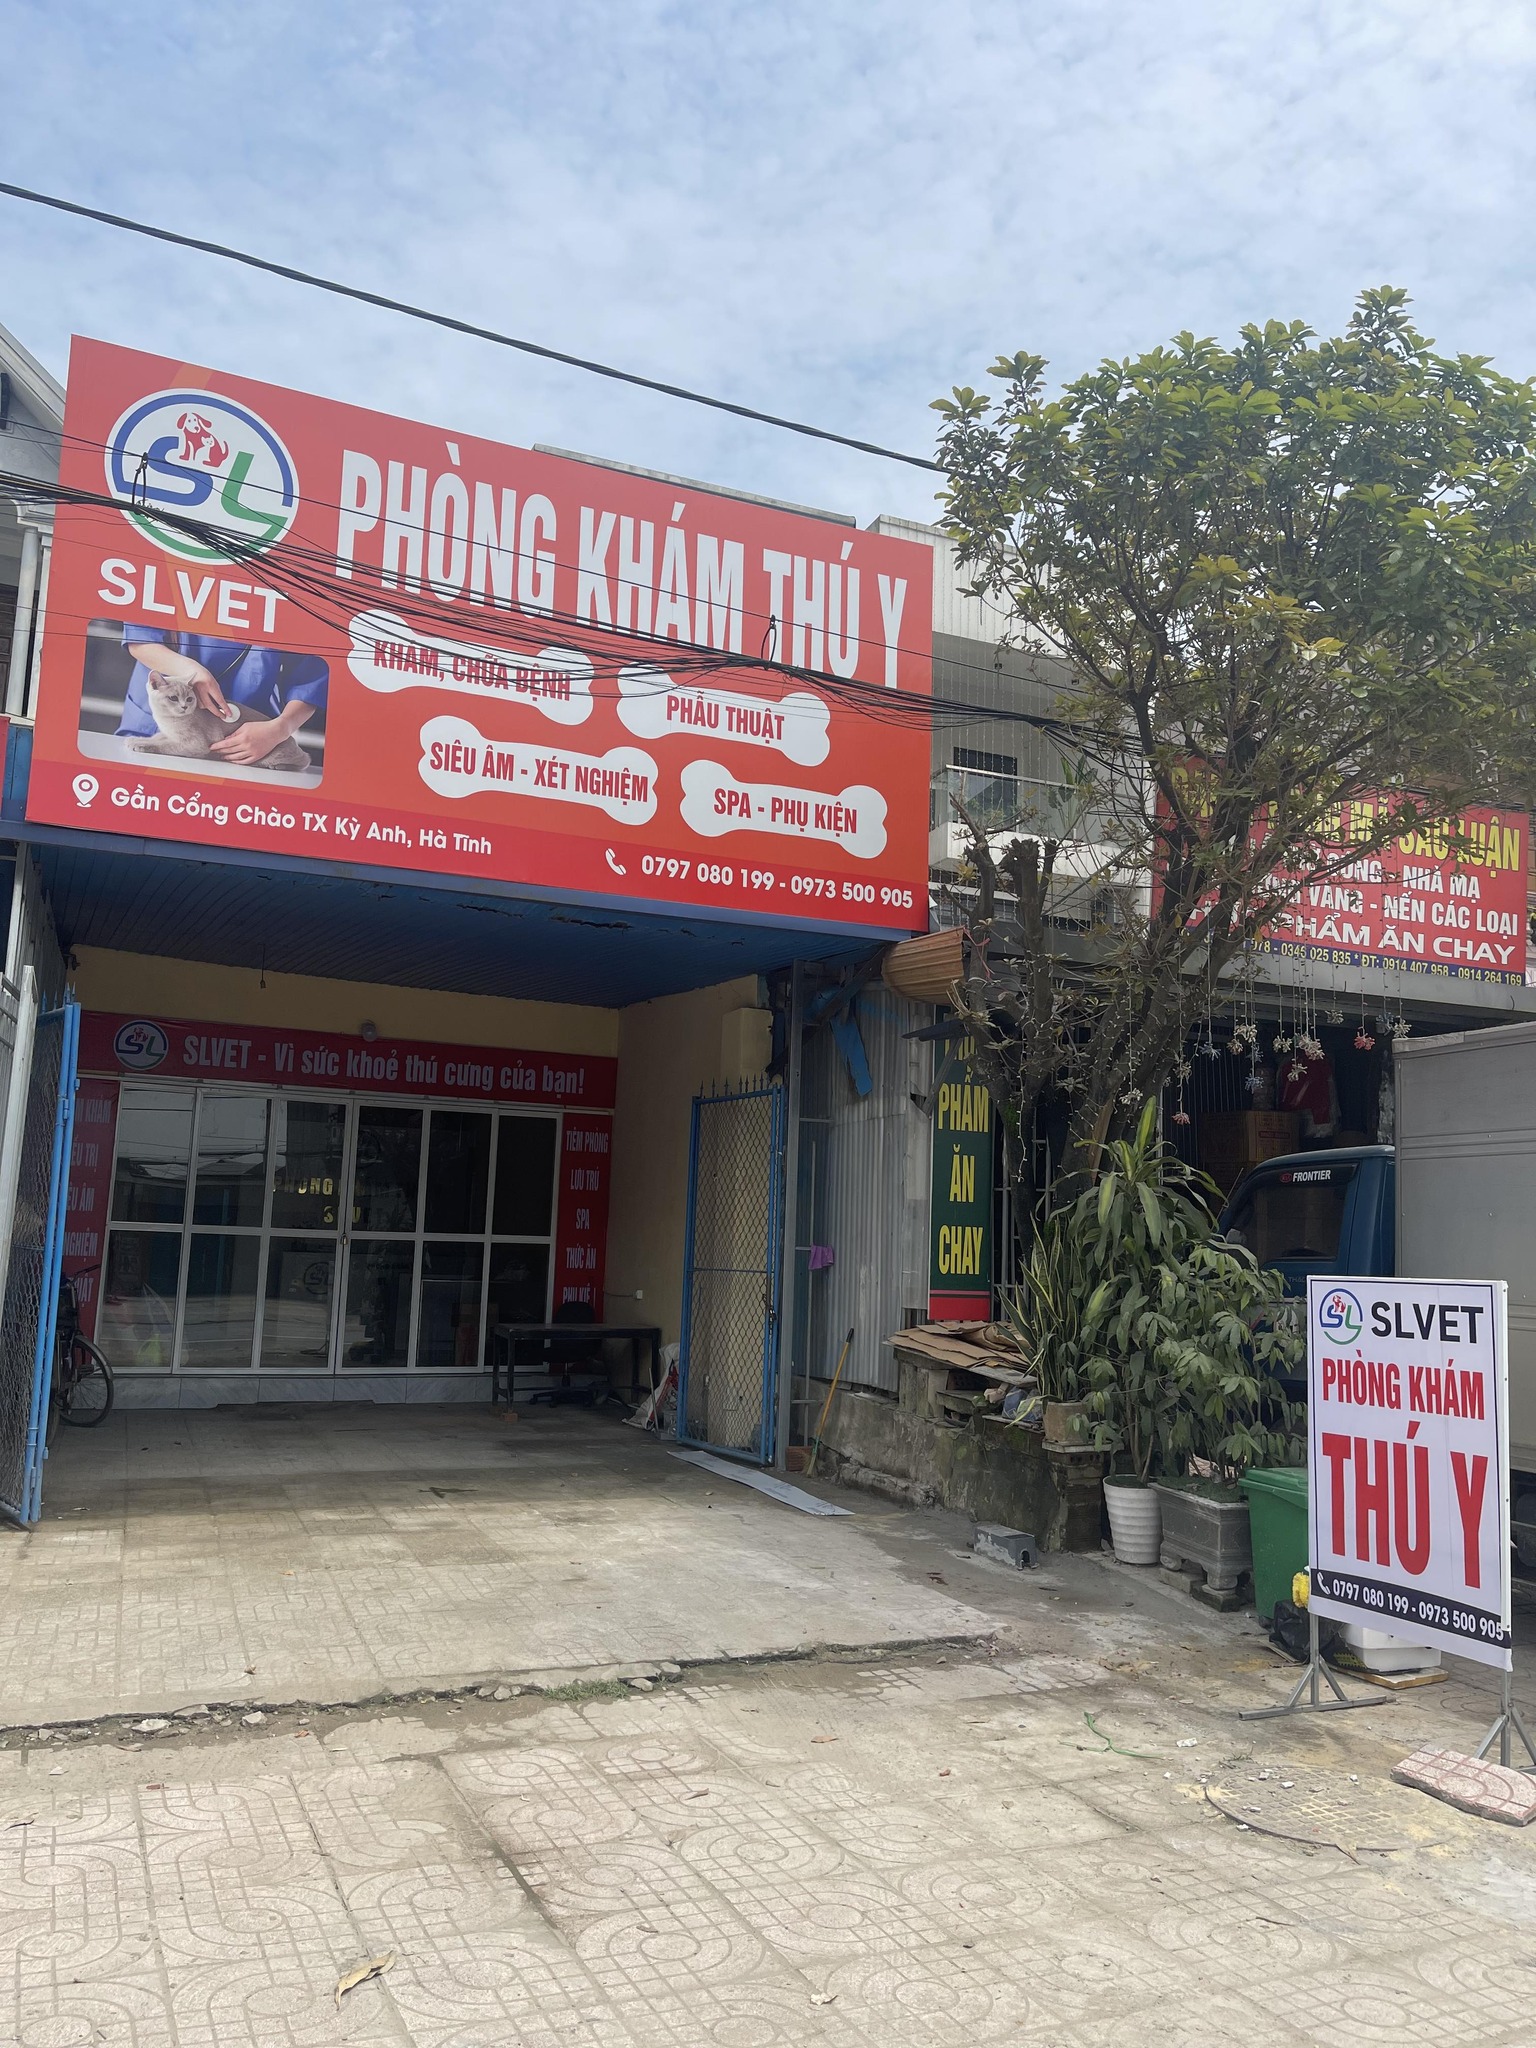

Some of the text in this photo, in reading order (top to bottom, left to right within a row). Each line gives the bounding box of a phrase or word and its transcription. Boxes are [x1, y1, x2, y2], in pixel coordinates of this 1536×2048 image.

[335, 441, 908, 691] PHÒNG KHÁM THÚ Y
[97, 557, 289, 634] SLVET
[452, 652, 509, 690] CHỮA
[515, 663, 571, 702] BỆNH
[666, 690, 785, 744] PHẪU THUẬT
[429, 739, 477, 776] SIÊU
[481, 744, 515, 782] ÂM
[533, 756, 570, 790] XÉT
[574, 767, 649, 806] NGHIỆM
[110, 783, 493, 855] Gần Cổng Chào TX Kỳ Anh, Hà Tĩnh
[713, 788, 752, 819] SPA
[770, 797, 809, 832] PHỤ
[814, 801, 858, 837] KIỆN
[1456, 815, 1521, 878] LUẬN
[641, 855, 691, 880] 0797
[696, 863, 733, 886] 080
[740, 868, 775, 891] 199
[791, 875, 836, 899] 0973
[842, 882, 875, 903] 500
[880, 889, 913, 909] 905
[1402, 865, 1444, 894] NHÀ
[1450, 874, 1481, 904] MẠ
[1309, 880, 1363, 914] VÀNG
[1384, 891, 1425, 923] NẾN
[1432, 900, 1470, 931] CÁC
[1476, 909, 1518, 940] LOẠI
[1271, 912, 1371, 948] PHẨM
[1378, 924, 1425, 954] ĂN
[1433, 937, 1516, 965] CHAY
[1310, 947, 1329, 961] 025
[1332, 950, 1351, 965] 835
[1362, 953, 1380, 969] ĐT:
[1383, 957, 1407, 971] 0914
[1410, 961, 1428, 974] 407
[1431, 963, 1449, 976] 958
[1458, 968, 1482, 981] 0914
[1484, 971, 1502, 983] 264
[1505, 974, 1522, 986] 169
[183, 1035, 252, 1069] SLVET
[274, 1042, 294, 1072] Vì
[301, 1046, 340, 1076] sức
[346, 1048, 399, 1081] khoẻ
[405, 1054, 438, 1084] thú
[444, 1062, 494, 1091] cưng
[500, 1060, 536, 1092] của
[542, 1065, 585, 1099] bạn!
[938, 1065, 989, 1133] PHẨM
[566, 1126, 609, 1154] TIÊM PHÒNG
[79, 1182, 95, 1212] ÂM
[949, 1143, 975, 1203] ĂN
[1292, 1170, 1331, 1182] FRONTIER
[575, 1207, 590, 1230] SPA
[566, 1242, 597, 1270] THỨC ĂN
[938, 1225, 983, 1275] CHAY
[1371, 1301, 1484, 1344] SLVET
[1322, 1349, 1485, 1420] PHÒNG KHÁM
[1322, 1420, 1489, 1589] THÚ Y
[1333, 1579, 1360, 1600] 0797
[1363, 1586, 1384, 1608] 080
[1387, 1592, 1409, 1614] 199
[1419, 1601, 1449, 1625] 0973
[1452, 1610, 1476, 1633] 500
[1479, 1618, 1504, 1641] 905
